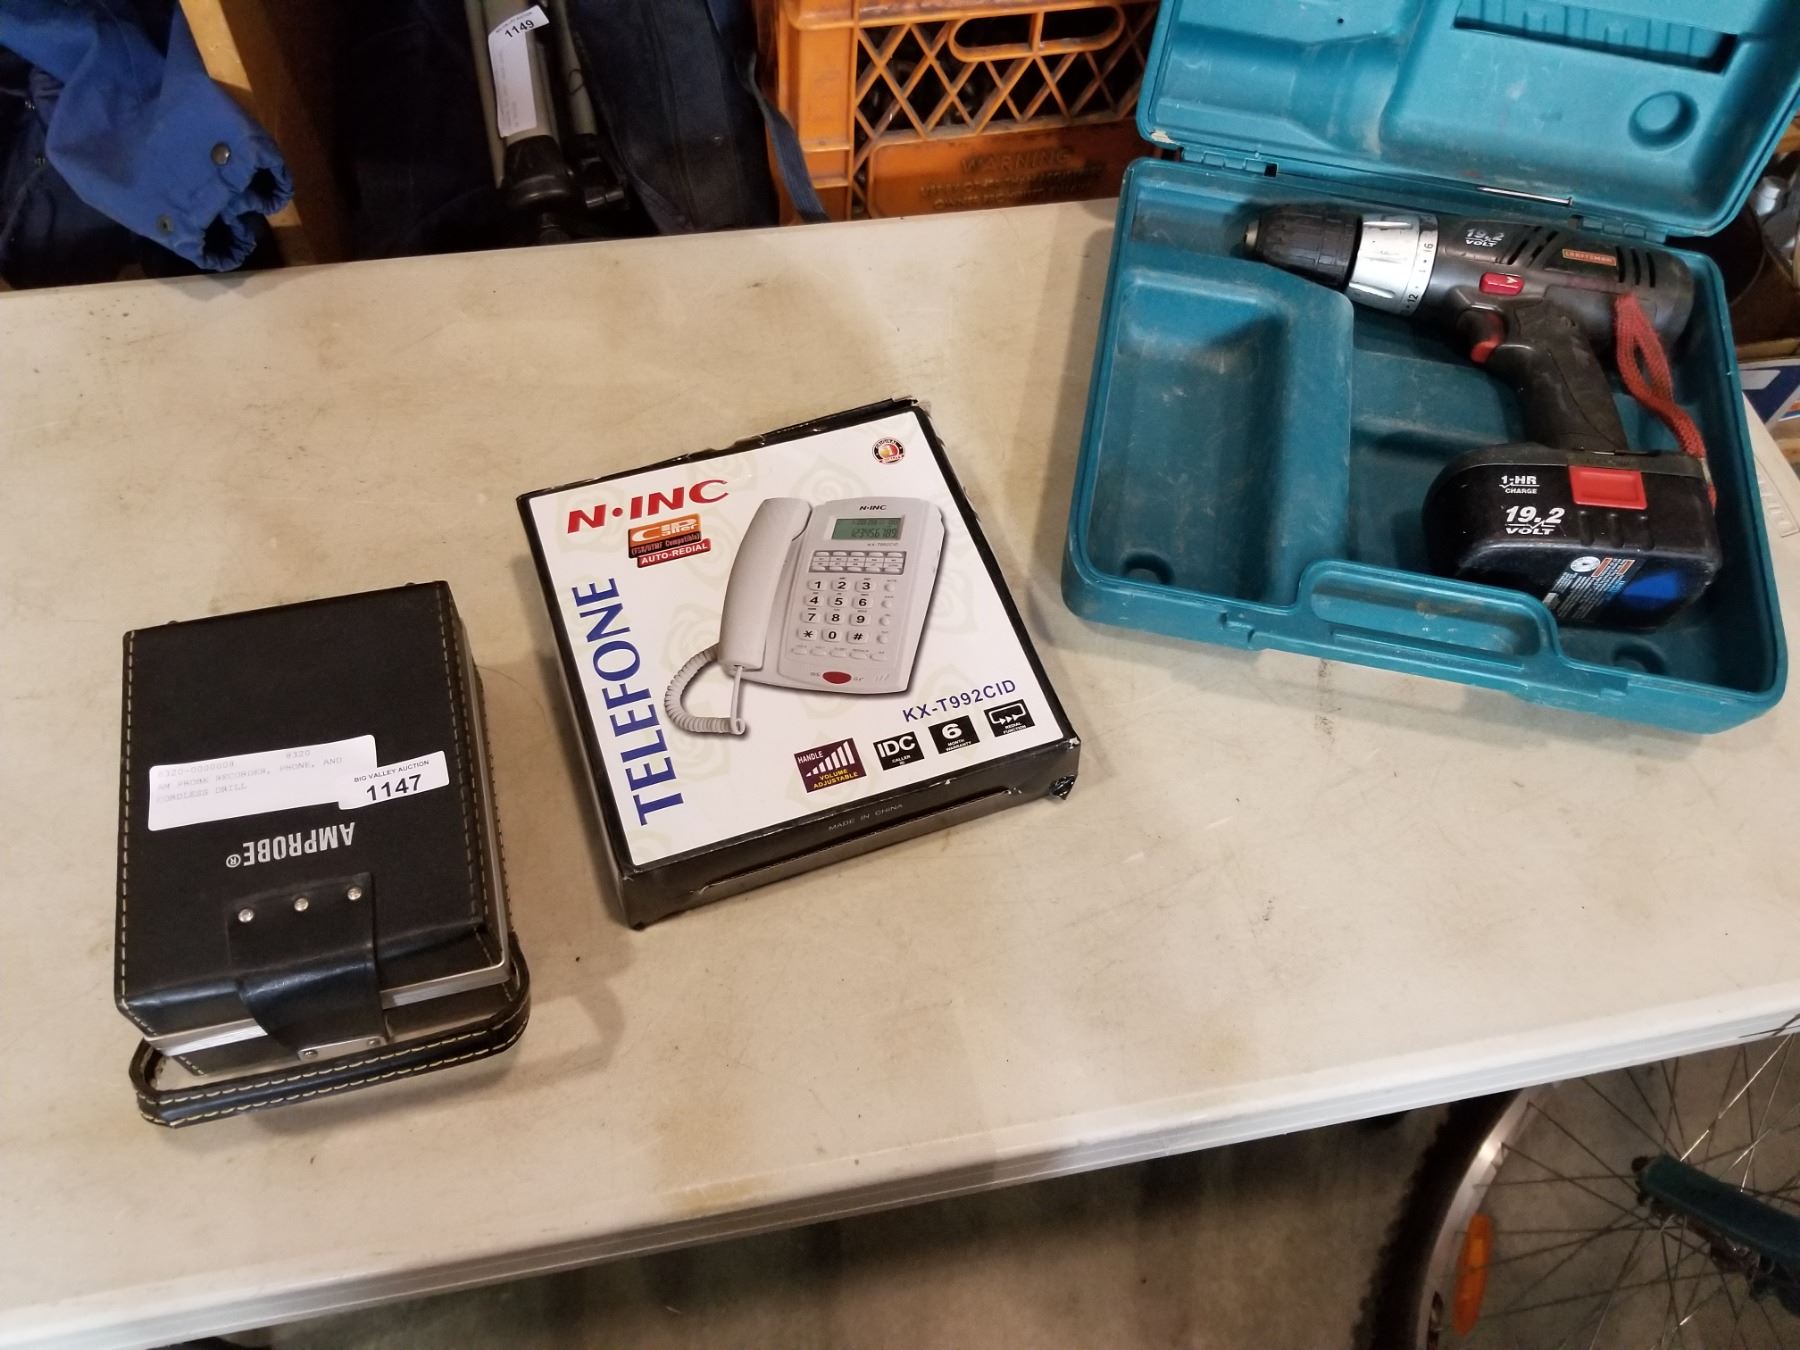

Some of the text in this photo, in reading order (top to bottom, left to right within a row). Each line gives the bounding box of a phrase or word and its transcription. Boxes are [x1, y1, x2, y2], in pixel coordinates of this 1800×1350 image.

[505, 20, 534, 38] 1149
[961, 150, 1071, 174] WARNING
[1467, 228, 1505, 241] 19.2
[1424, 243, 1434, 253] 16
[1465, 239, 1497, 247] VOLT
[1407, 294, 1419, 303] 12
[1501, 475, 1538, 485] 1-HR
[1505, 506, 1565, 524] 19.2
[1505, 527, 1556, 535] VOLT
[641, 543, 708, 565] AUTO-REDIAL
[814, 581, 821, 589] 1
[837, 581, 847, 590] 2
[862, 582, 871, 590] 3
[809, 596, 819, 604] 4
[834, 597, 843, 606] 5
[858, 598, 867, 606] 6
[808, 613, 816, 621] 7
[831, 613, 840, 622] 8
[856, 615, 865, 623] 9
[828, 631, 837, 640] 0
[571, 578, 684, 826] TELEFONE
[902, 679, 1016, 723] KX-T992CID
[941, 723, 962, 739] 6
[877, 735, 916, 758] IDC
[947, 739, 965, 747] MONTH
[797, 751, 824, 764] HANDLE
[892, 754, 911, 763] CALLER
[354, 759, 430, 783] BIG VALLEY AUCTION
[819, 769, 849, 780] VOLUME
[813, 772, 859, 790] ADJUSTABLE
[366, 773, 422, 801] 1147
[828, 818, 856, 831] MADE
[875, 804, 903, 816] CHINA
